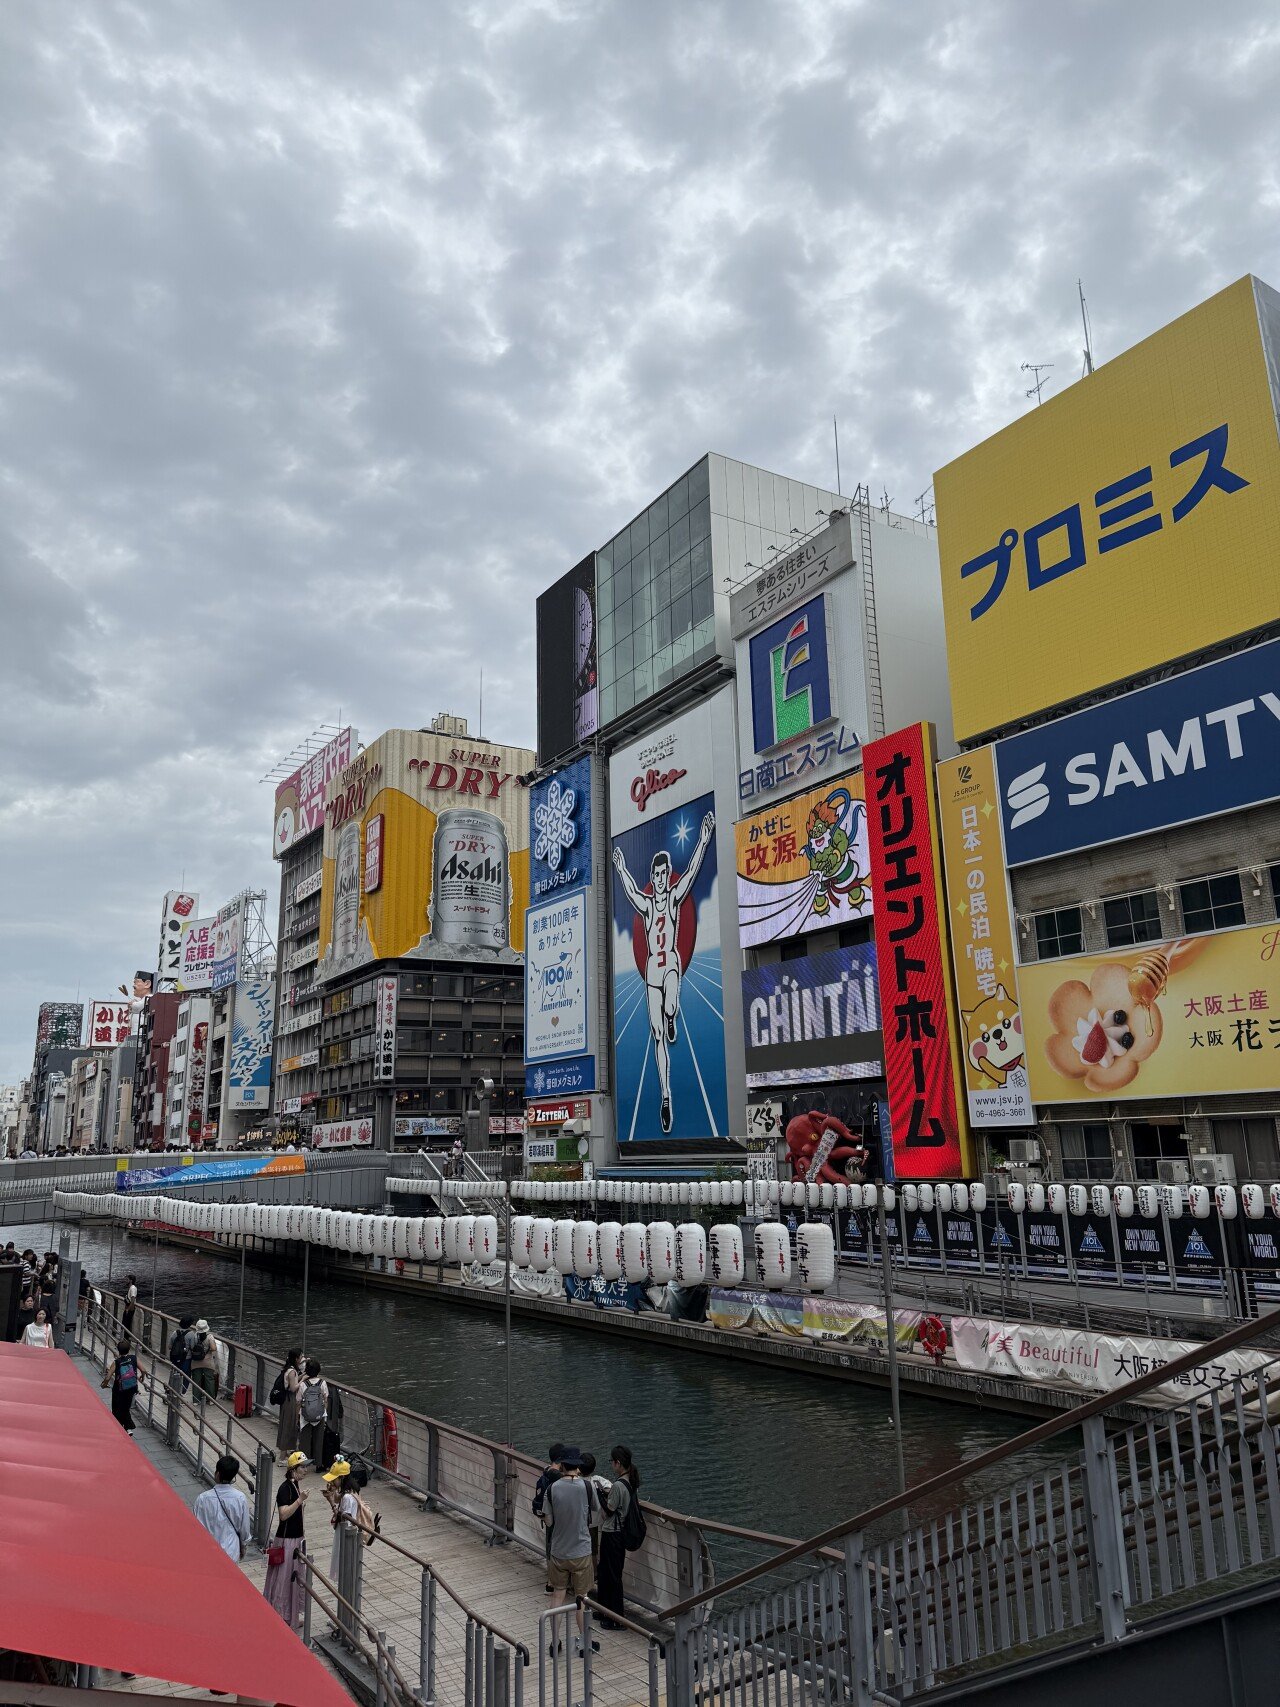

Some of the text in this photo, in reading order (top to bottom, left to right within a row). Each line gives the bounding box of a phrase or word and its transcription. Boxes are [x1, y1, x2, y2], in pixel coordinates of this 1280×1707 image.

[961, 422, 1251, 622] プロミス
[756, 545, 817, 597] 夢ある住まい
[748, 556, 830, 622] エステムシリーズ
[449, 749, 501, 767] SUPER
[739, 725, 860, 801] 日商エステム
[342, 755, 367, 785] SUPER
[631, 768, 687, 811] Glico
[954, 790, 960, 798] JS
[960, 783, 981, 795] GROUP
[462, 834, 484, 842] SUPER
[749, 815, 792, 842] かぜに
[745, 830, 798, 876] 改源
[441, 853, 501, 885] Asahi
[535, 867, 578, 895] 雪印メグミルク
[464, 885, 480, 897] 生
[453, 905, 490, 915] スーパードライ
[533, 905, 579, 934] 創業100周年
[186, 927, 209, 945] 入店
[538, 928, 573, 951] ありがとう
[655, 912, 667, 968] グリコ
[876, 752, 947, 1148] オリエントホーム
[544, 966, 572, 986] 100th
[539, 998, 573, 1012] Anniversary
[750, 960, 878, 1048] CHINTAI
[1183, 989, 1269, 1019] 大阪土産
[96, 1006, 131, 1024] かに
[1188, 1029, 1224, 1048] 大阪
[382, 1029, 393, 1076] かに道楽
[547, 1074, 582, 1090] 雪印メグミルク
[975, 1094, 1023, 1106] www.jsv.jp
[536, 1109, 569, 1121] ZETTERIA
[329, 1126, 352, 1143] かに道楽
[959, 1222, 971, 1231] YOUR
[1030, 1225, 1056, 1236] OWN YOUR
[1126, 1229, 1156, 1241] OWN YOUR
[958, 1232, 973, 1242] WORLD
[1029, 1235, 1060, 1246] NEW WORLD
[1125, 1240, 1160, 1252] NEW WORLD
[1254, 1234, 1272, 1246] YOUR
[710, 1233, 721, 1280] 三津寺
[754, 1233, 766, 1281] 三津寺
[1254, 1246, 1277, 1258] WORLD
[996, 1336, 1099, 1368] 美 Beautiful
[1068, 1372, 1099, 1382] NIVERSITY
